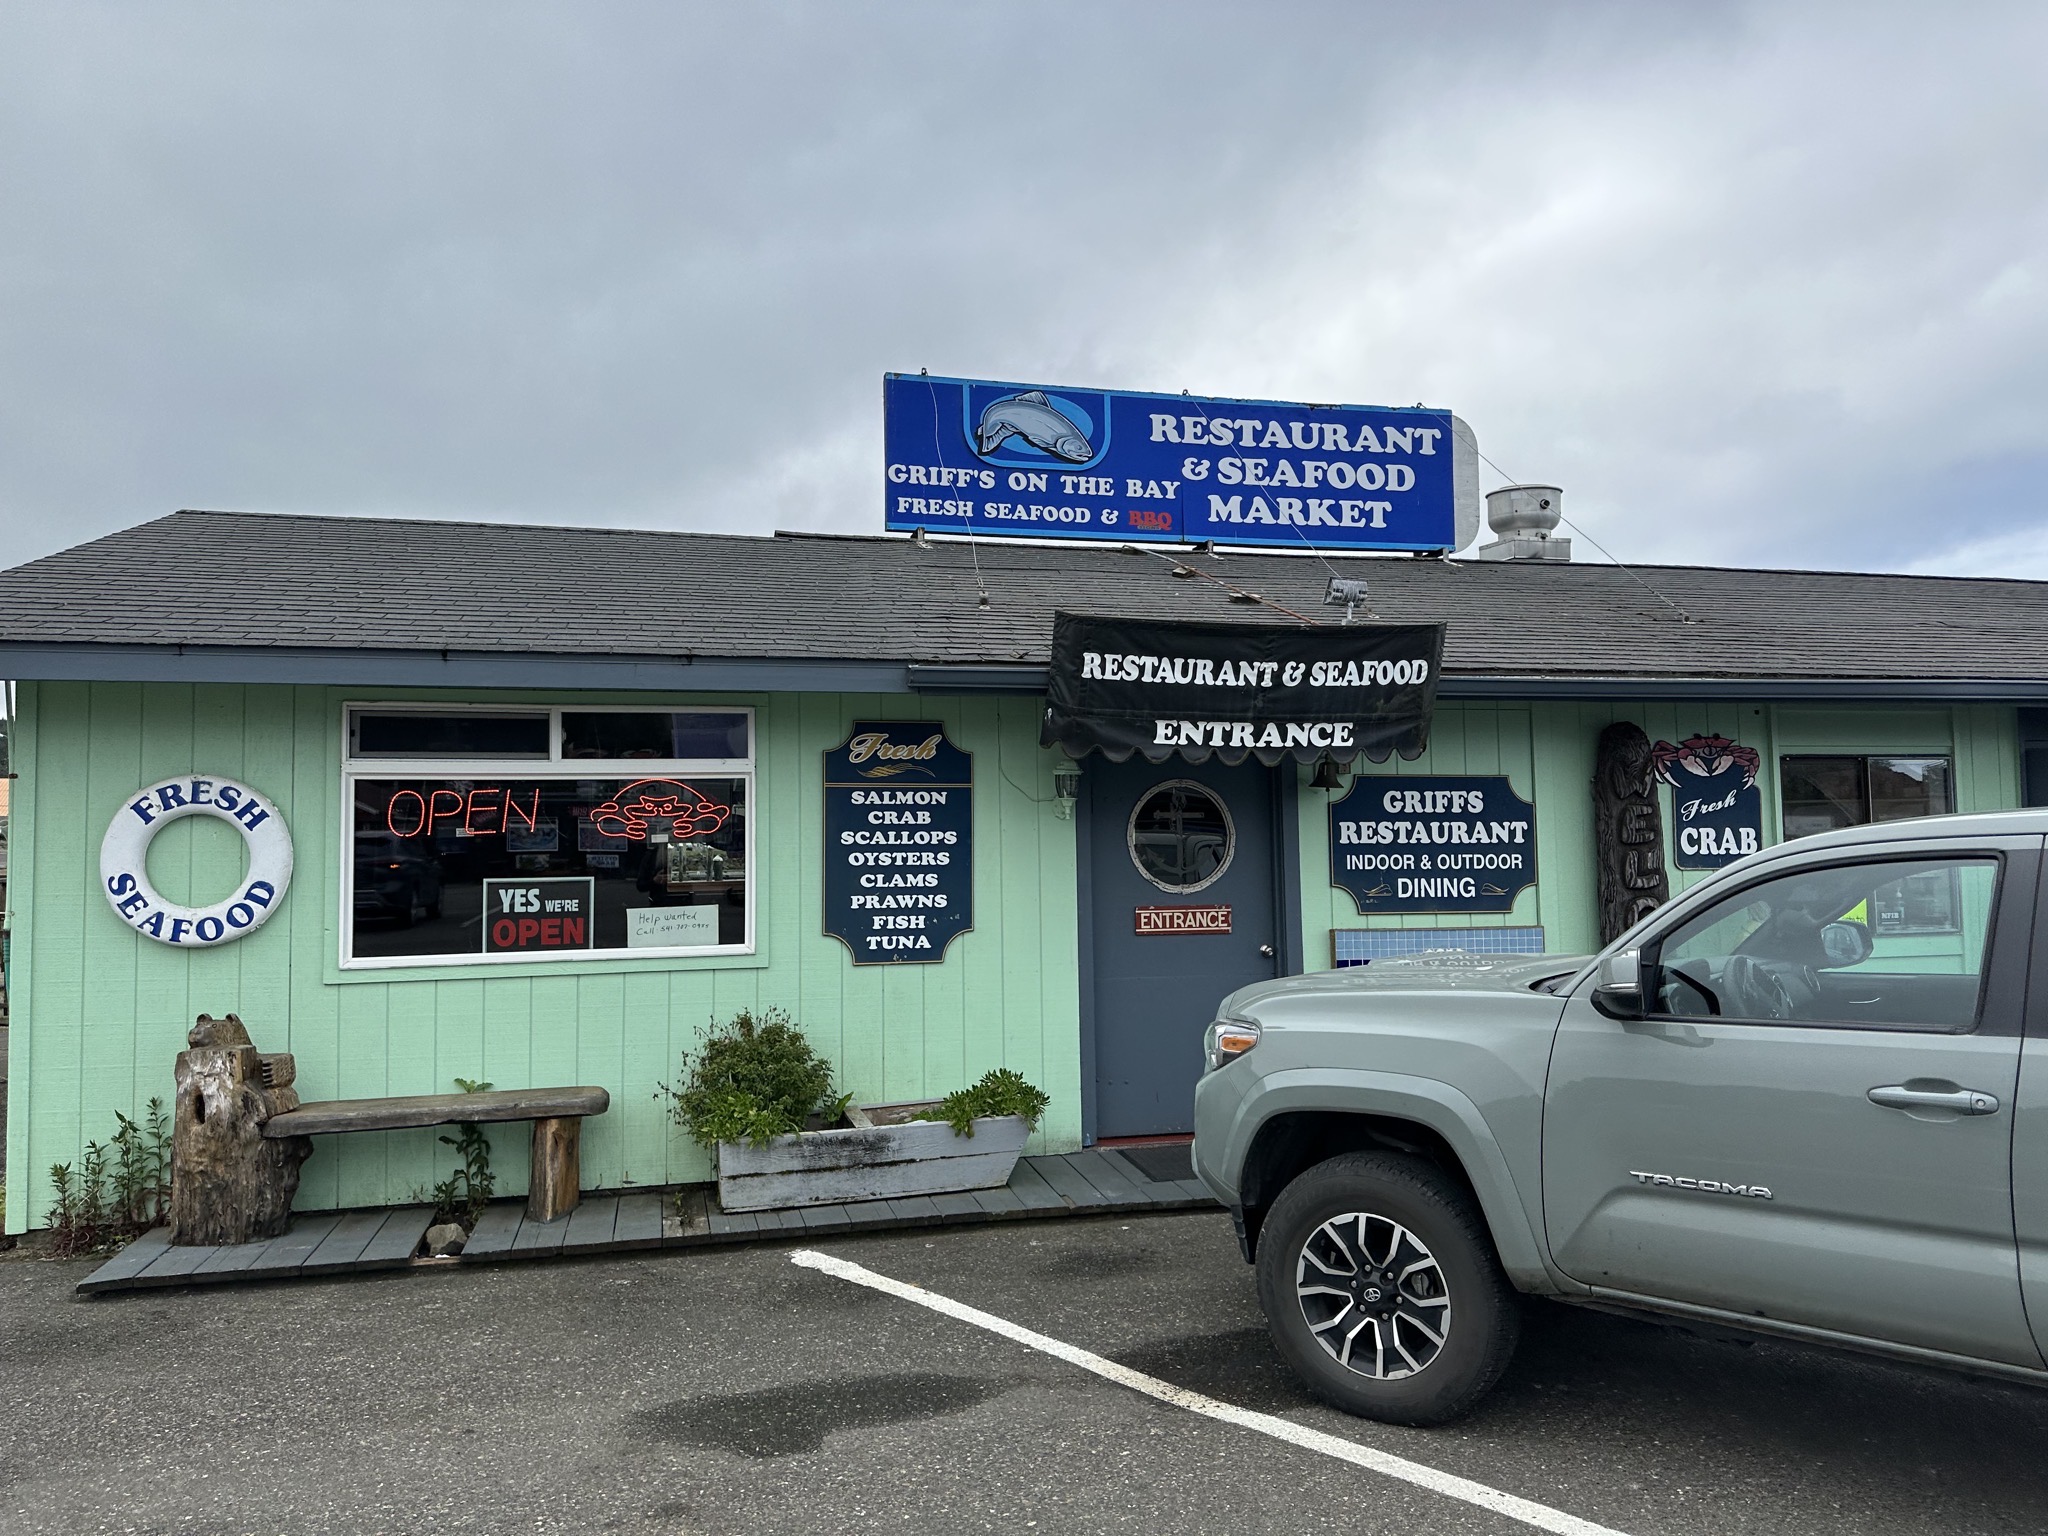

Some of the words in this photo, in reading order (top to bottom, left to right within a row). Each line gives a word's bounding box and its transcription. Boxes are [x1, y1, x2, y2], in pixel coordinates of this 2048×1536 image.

[1149, 414, 1441, 455] RESTAURANT
[888, 464, 996, 489] GRIFF'S
[1008, 472, 1048, 492] ON
[1060, 475, 1114, 496] THE
[1126, 479, 1180, 499] BAY
[1182, 457, 1210, 481] &
[1217, 457, 1416, 491] SEAFOOD
[897, 497, 973, 517] FRESH
[984, 503, 1091, 524] SEAFOOD
[1100, 509, 1119, 525] &
[1128, 510, 1172, 531] BBQ
[1208, 495, 1392, 528] MARKET
[1081, 652, 1278, 687] RESTAURANT
[1282, 659, 1305, 687] &
[1309, 659, 1429, 687] SEAFOOD
[1153, 720, 1354, 748] ENTRANCE
[849, 733, 943, 763] Fresh
[130, 780, 271, 832] FRESH
[851, 791, 948, 805] SALMON
[1383, 790, 1484, 814] GRIFFS
[1680, 789, 1737, 822] Fresh
[387, 788, 540, 837] OPEN
[867, 811, 931, 825] CRAB
[840, 831, 957, 845] SCALLOPS
[1339, 821, 1528, 844] RESTAURANT
[1680, 827, 1758, 855] CRAB
[848, 852, 950, 866] OYSTERS
[1346, 854, 1415, 870] INDOOR
[1420, 854, 1432, 870] &
[1437, 853, 1522, 870] OUTDOOR
[860, 874, 938, 888] CLAMS
[1397, 877, 1476, 898] DINING
[107, 873, 276, 943] SEAFOOD
[498, 888, 541, 913] YES
[545, 898, 579, 912] WE'RE
[850, 894, 948, 909] PRAWNS
[638, 912, 661, 926] Help
[664, 910, 697, 921] wanted
[872, 915, 926, 929] FISH
[1140, 911, 1228, 929] ENTRANCE
[492, 917, 584, 947] OPEN
[866, 935, 932, 950] TUNA
[1629, 1170, 1774, 1199] TACOMA
